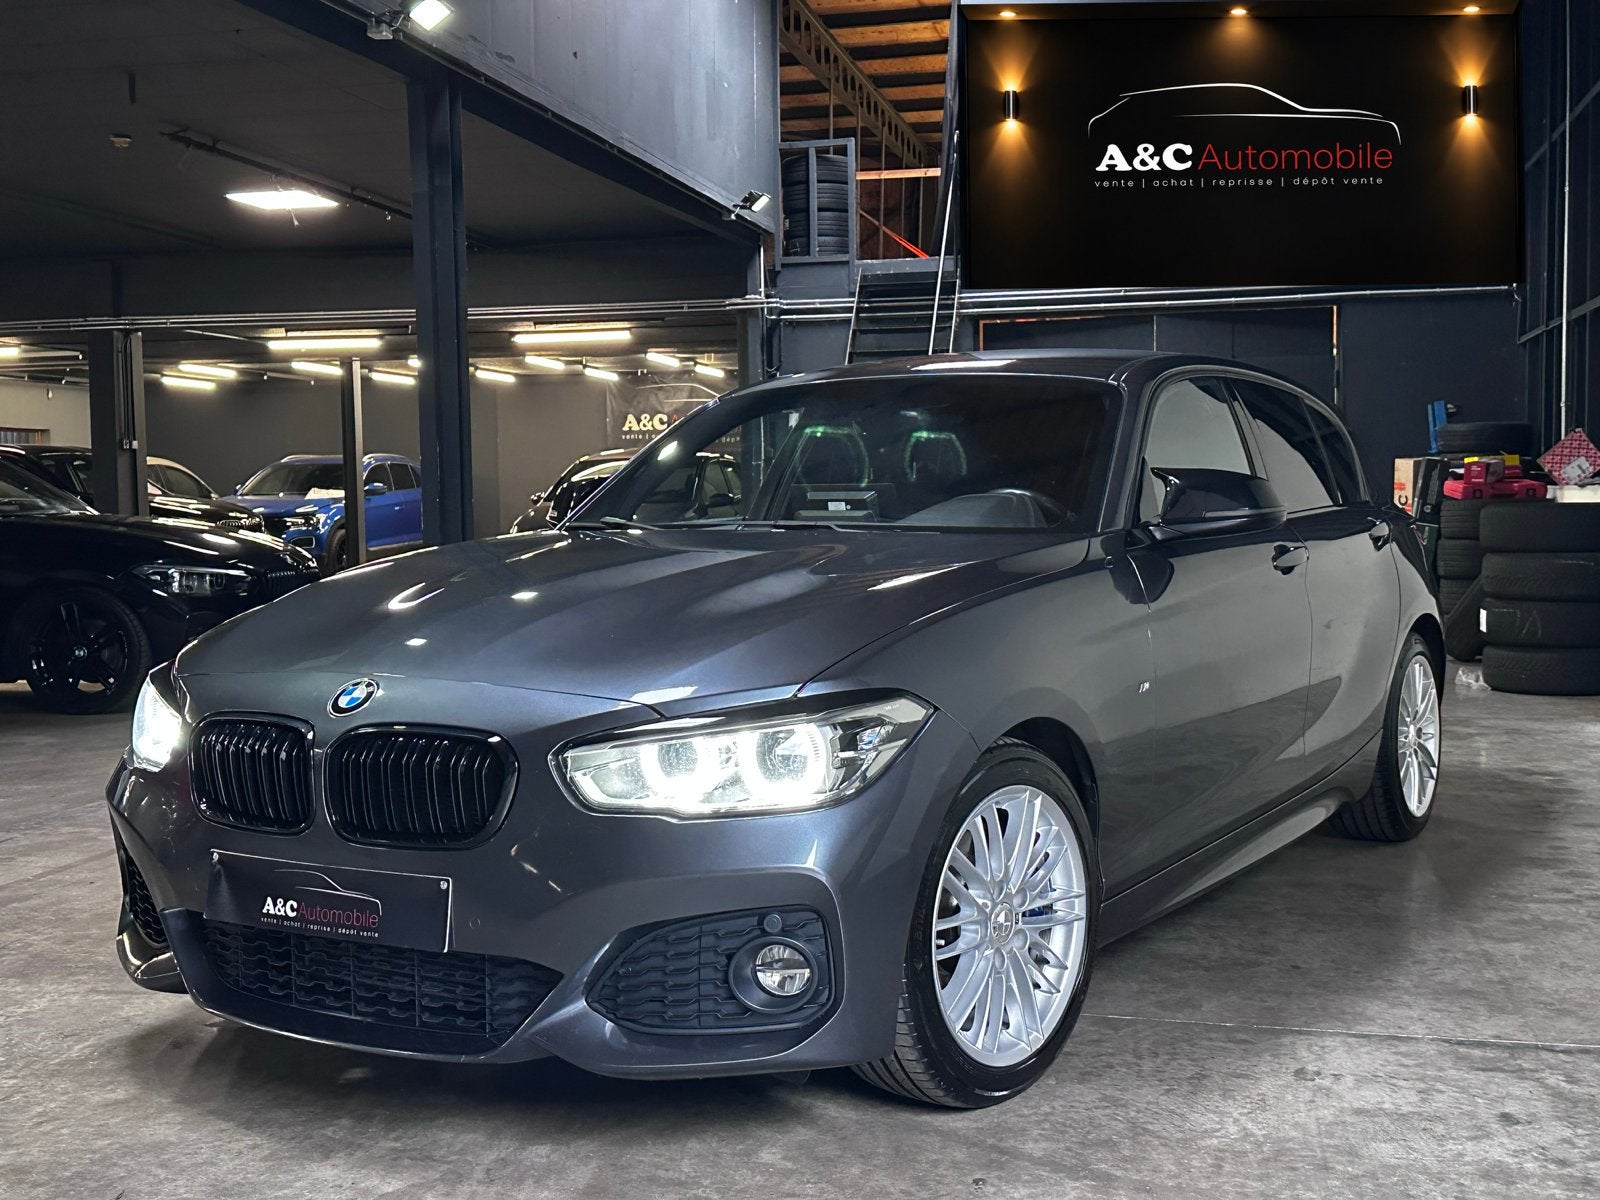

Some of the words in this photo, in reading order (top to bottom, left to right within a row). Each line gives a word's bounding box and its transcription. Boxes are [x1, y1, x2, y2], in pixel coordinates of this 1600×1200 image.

[1095, 142, 1193, 172] A&C
[1197, 142, 1393, 172] Automobile
[1094, 179, 1134, 188] vente
[1152, 178, 1194, 188] achat
[1212, 177, 1273, 188] reprisse
[1293, 176, 1335, 187] dépôt
[1343, 177, 1384, 186] vente
[622, 412, 668, 431] A&C
[262, 896, 298, 918] A&C
[299, 902, 379, 928] Automobile
